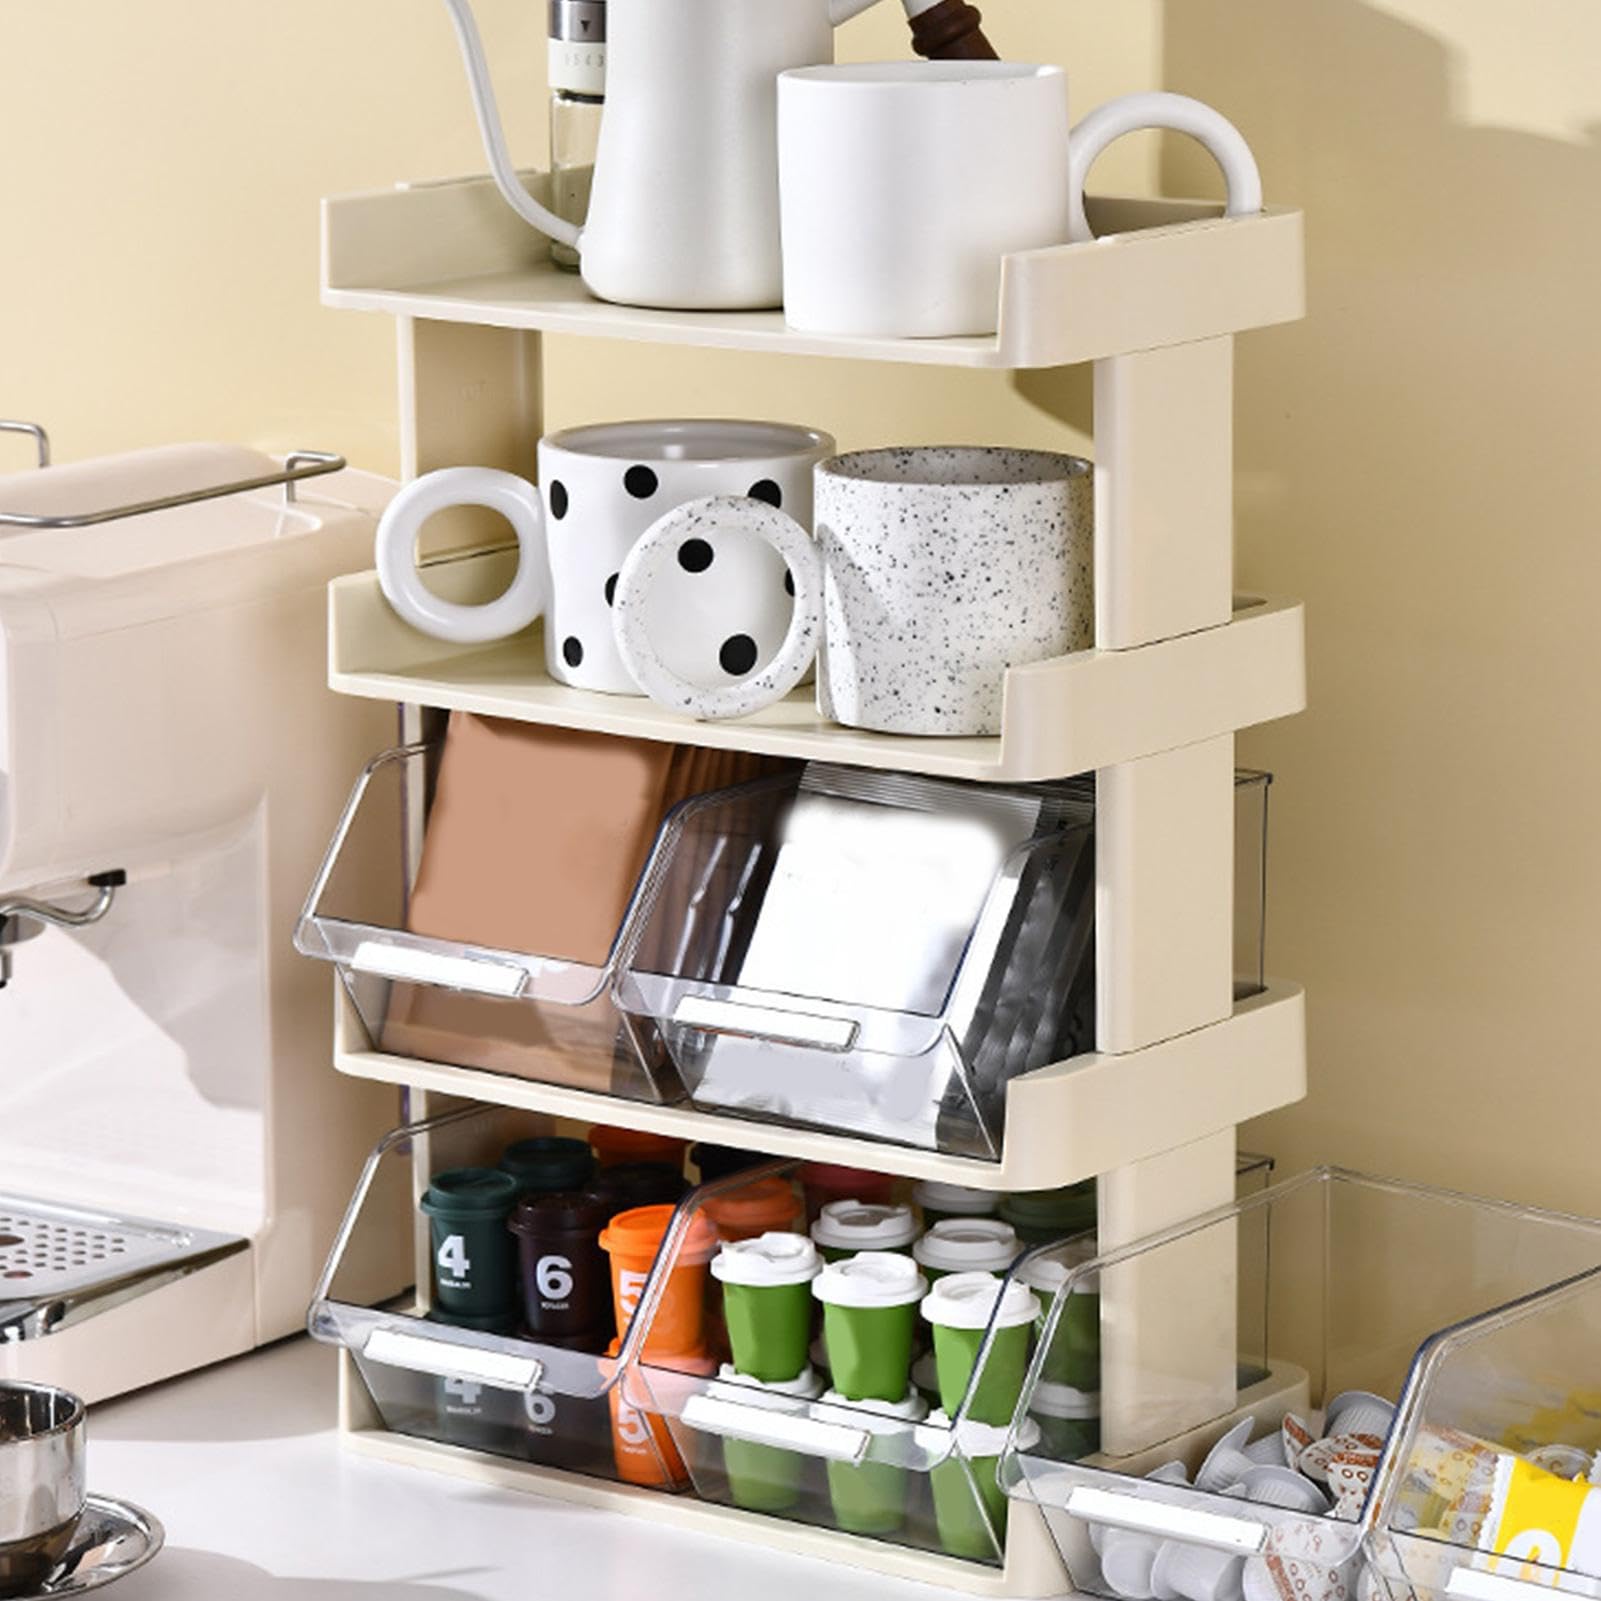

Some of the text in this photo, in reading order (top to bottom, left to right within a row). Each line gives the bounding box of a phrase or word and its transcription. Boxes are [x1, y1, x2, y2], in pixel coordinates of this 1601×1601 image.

[438, 1234, 471, 1278] 4
[536, 1255, 573, 1299] 6
[619, 1269, 649, 1314] 5
[524, 1383, 556, 1424] 6
[618, 1397, 650, 1444] 5
